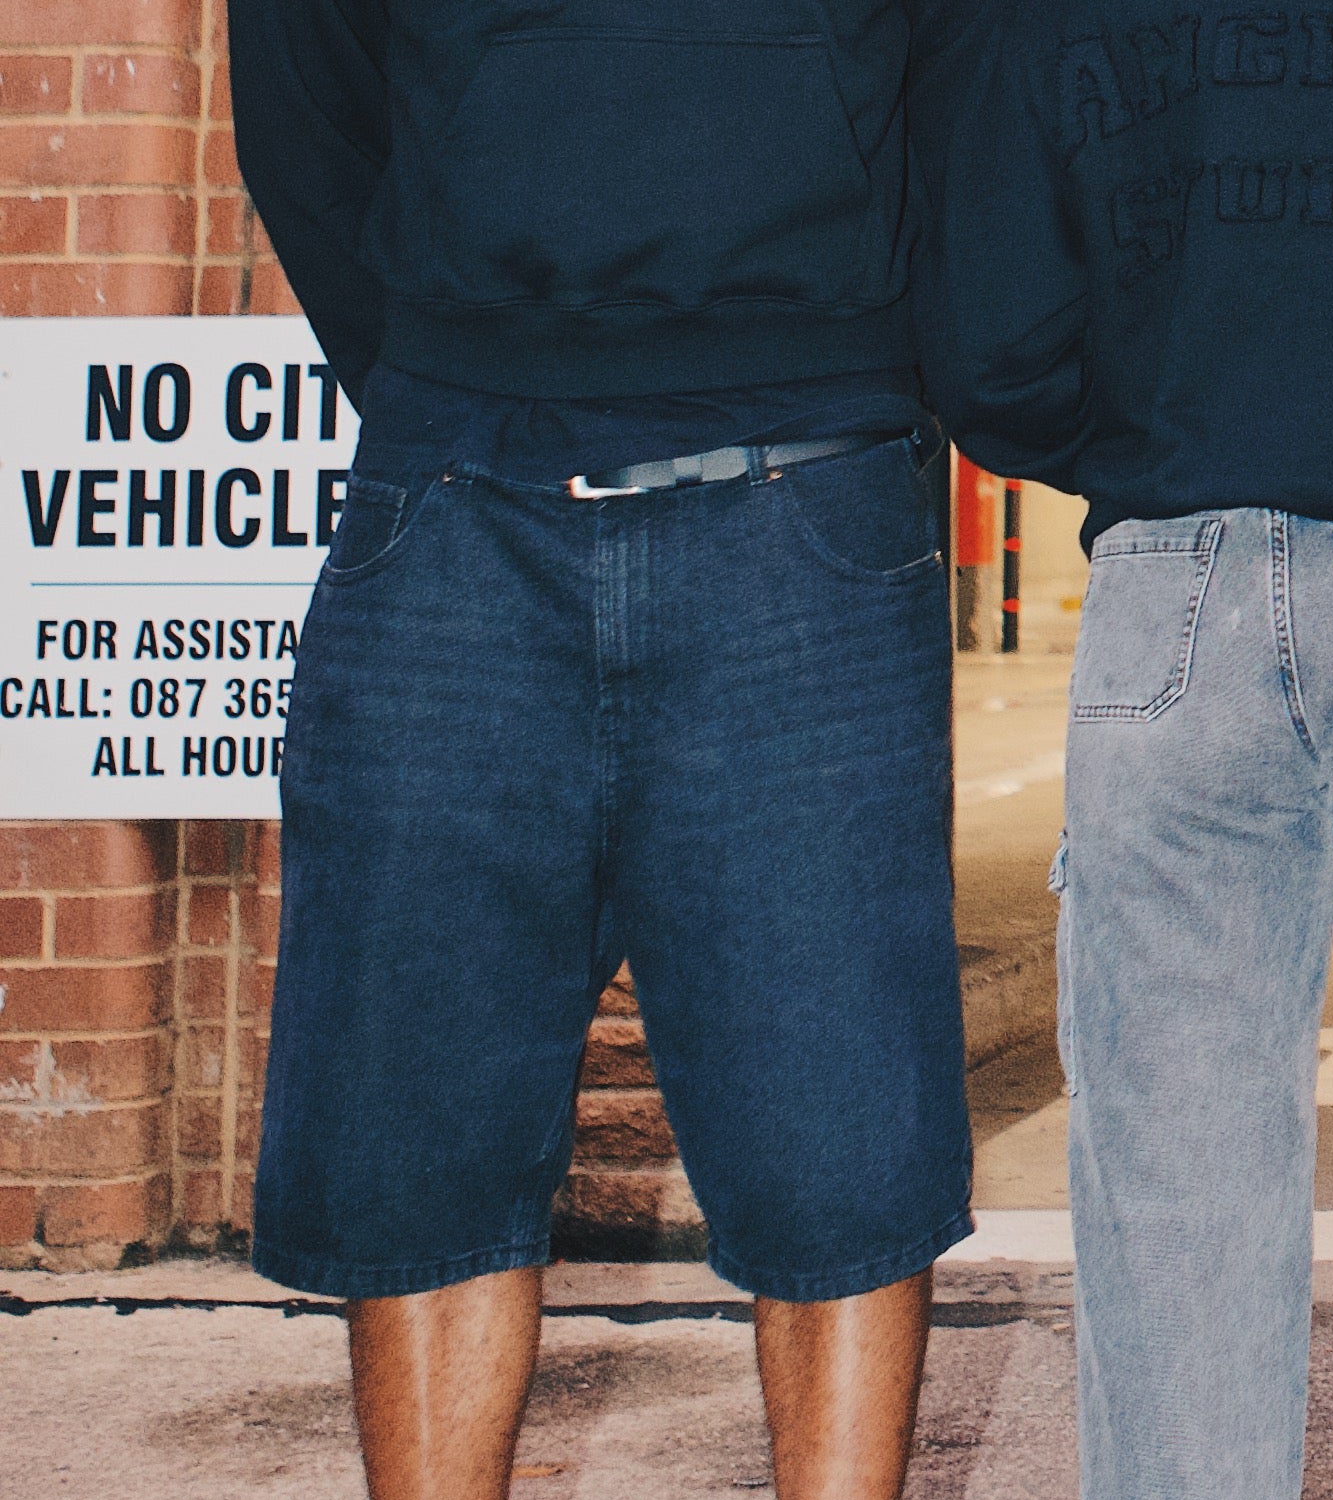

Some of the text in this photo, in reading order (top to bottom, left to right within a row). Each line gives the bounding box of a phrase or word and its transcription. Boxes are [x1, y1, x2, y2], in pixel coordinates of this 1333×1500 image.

[86, 362, 339, 442] NO CIT
[22, 467, 351, 549] VEHICLE
[37, 619, 298, 661] FOR ASSISTA
[0, 677, 112, 719] CALL:
[130, 678, 207, 719] 087
[91, 736, 165, 777] ALL
